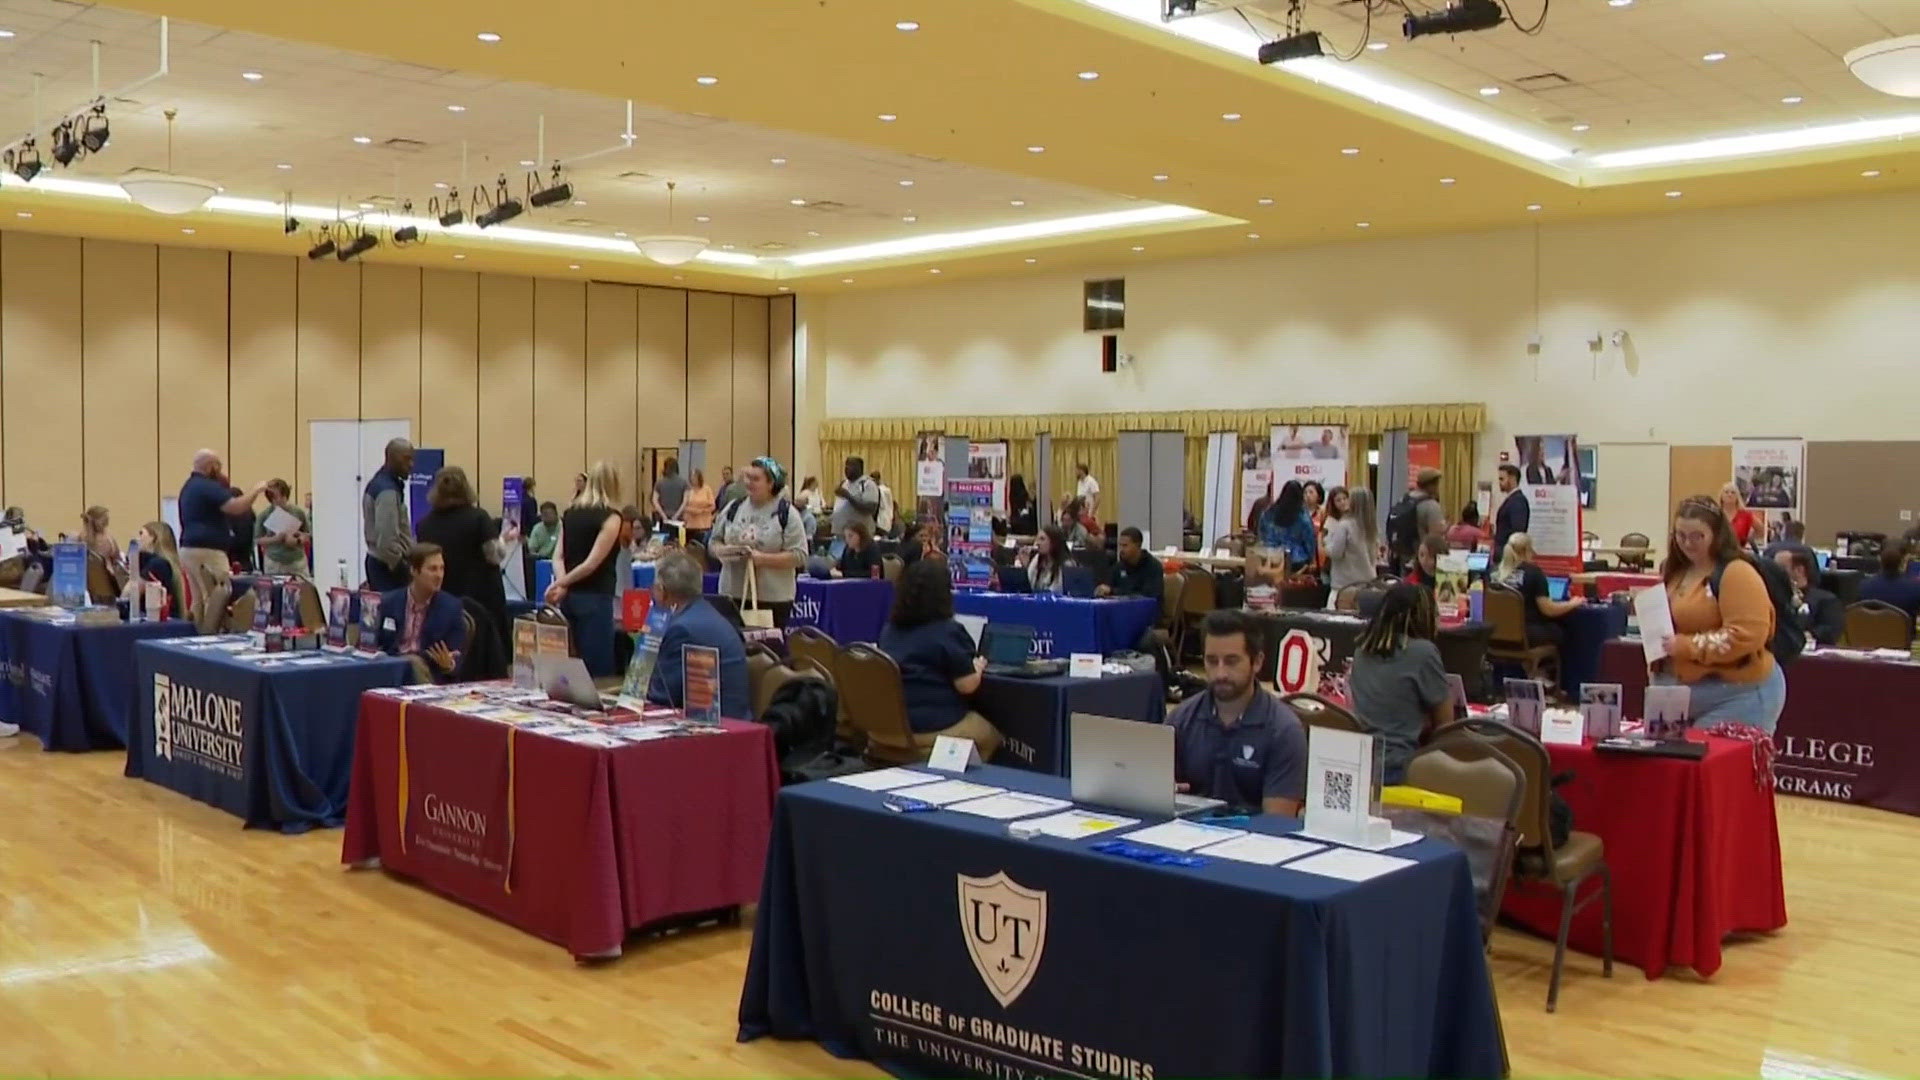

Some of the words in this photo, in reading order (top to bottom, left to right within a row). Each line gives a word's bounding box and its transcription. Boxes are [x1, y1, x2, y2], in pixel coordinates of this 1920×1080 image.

[171, 682, 243, 737] MALONE
[172, 720, 243, 766] UNIVERSITY
[424, 793, 486, 837] GANNON
[970, 898, 1031, 960] UT
[870, 989, 943, 1026] COLLEGE
[970, 1016, 1064, 1061] GRADUATE
[1071, 1043, 1155, 1080] STUDIES
[873, 1026, 911, 1050] THE
[917, 1038, 1026, 1080] UNIVERSITY
